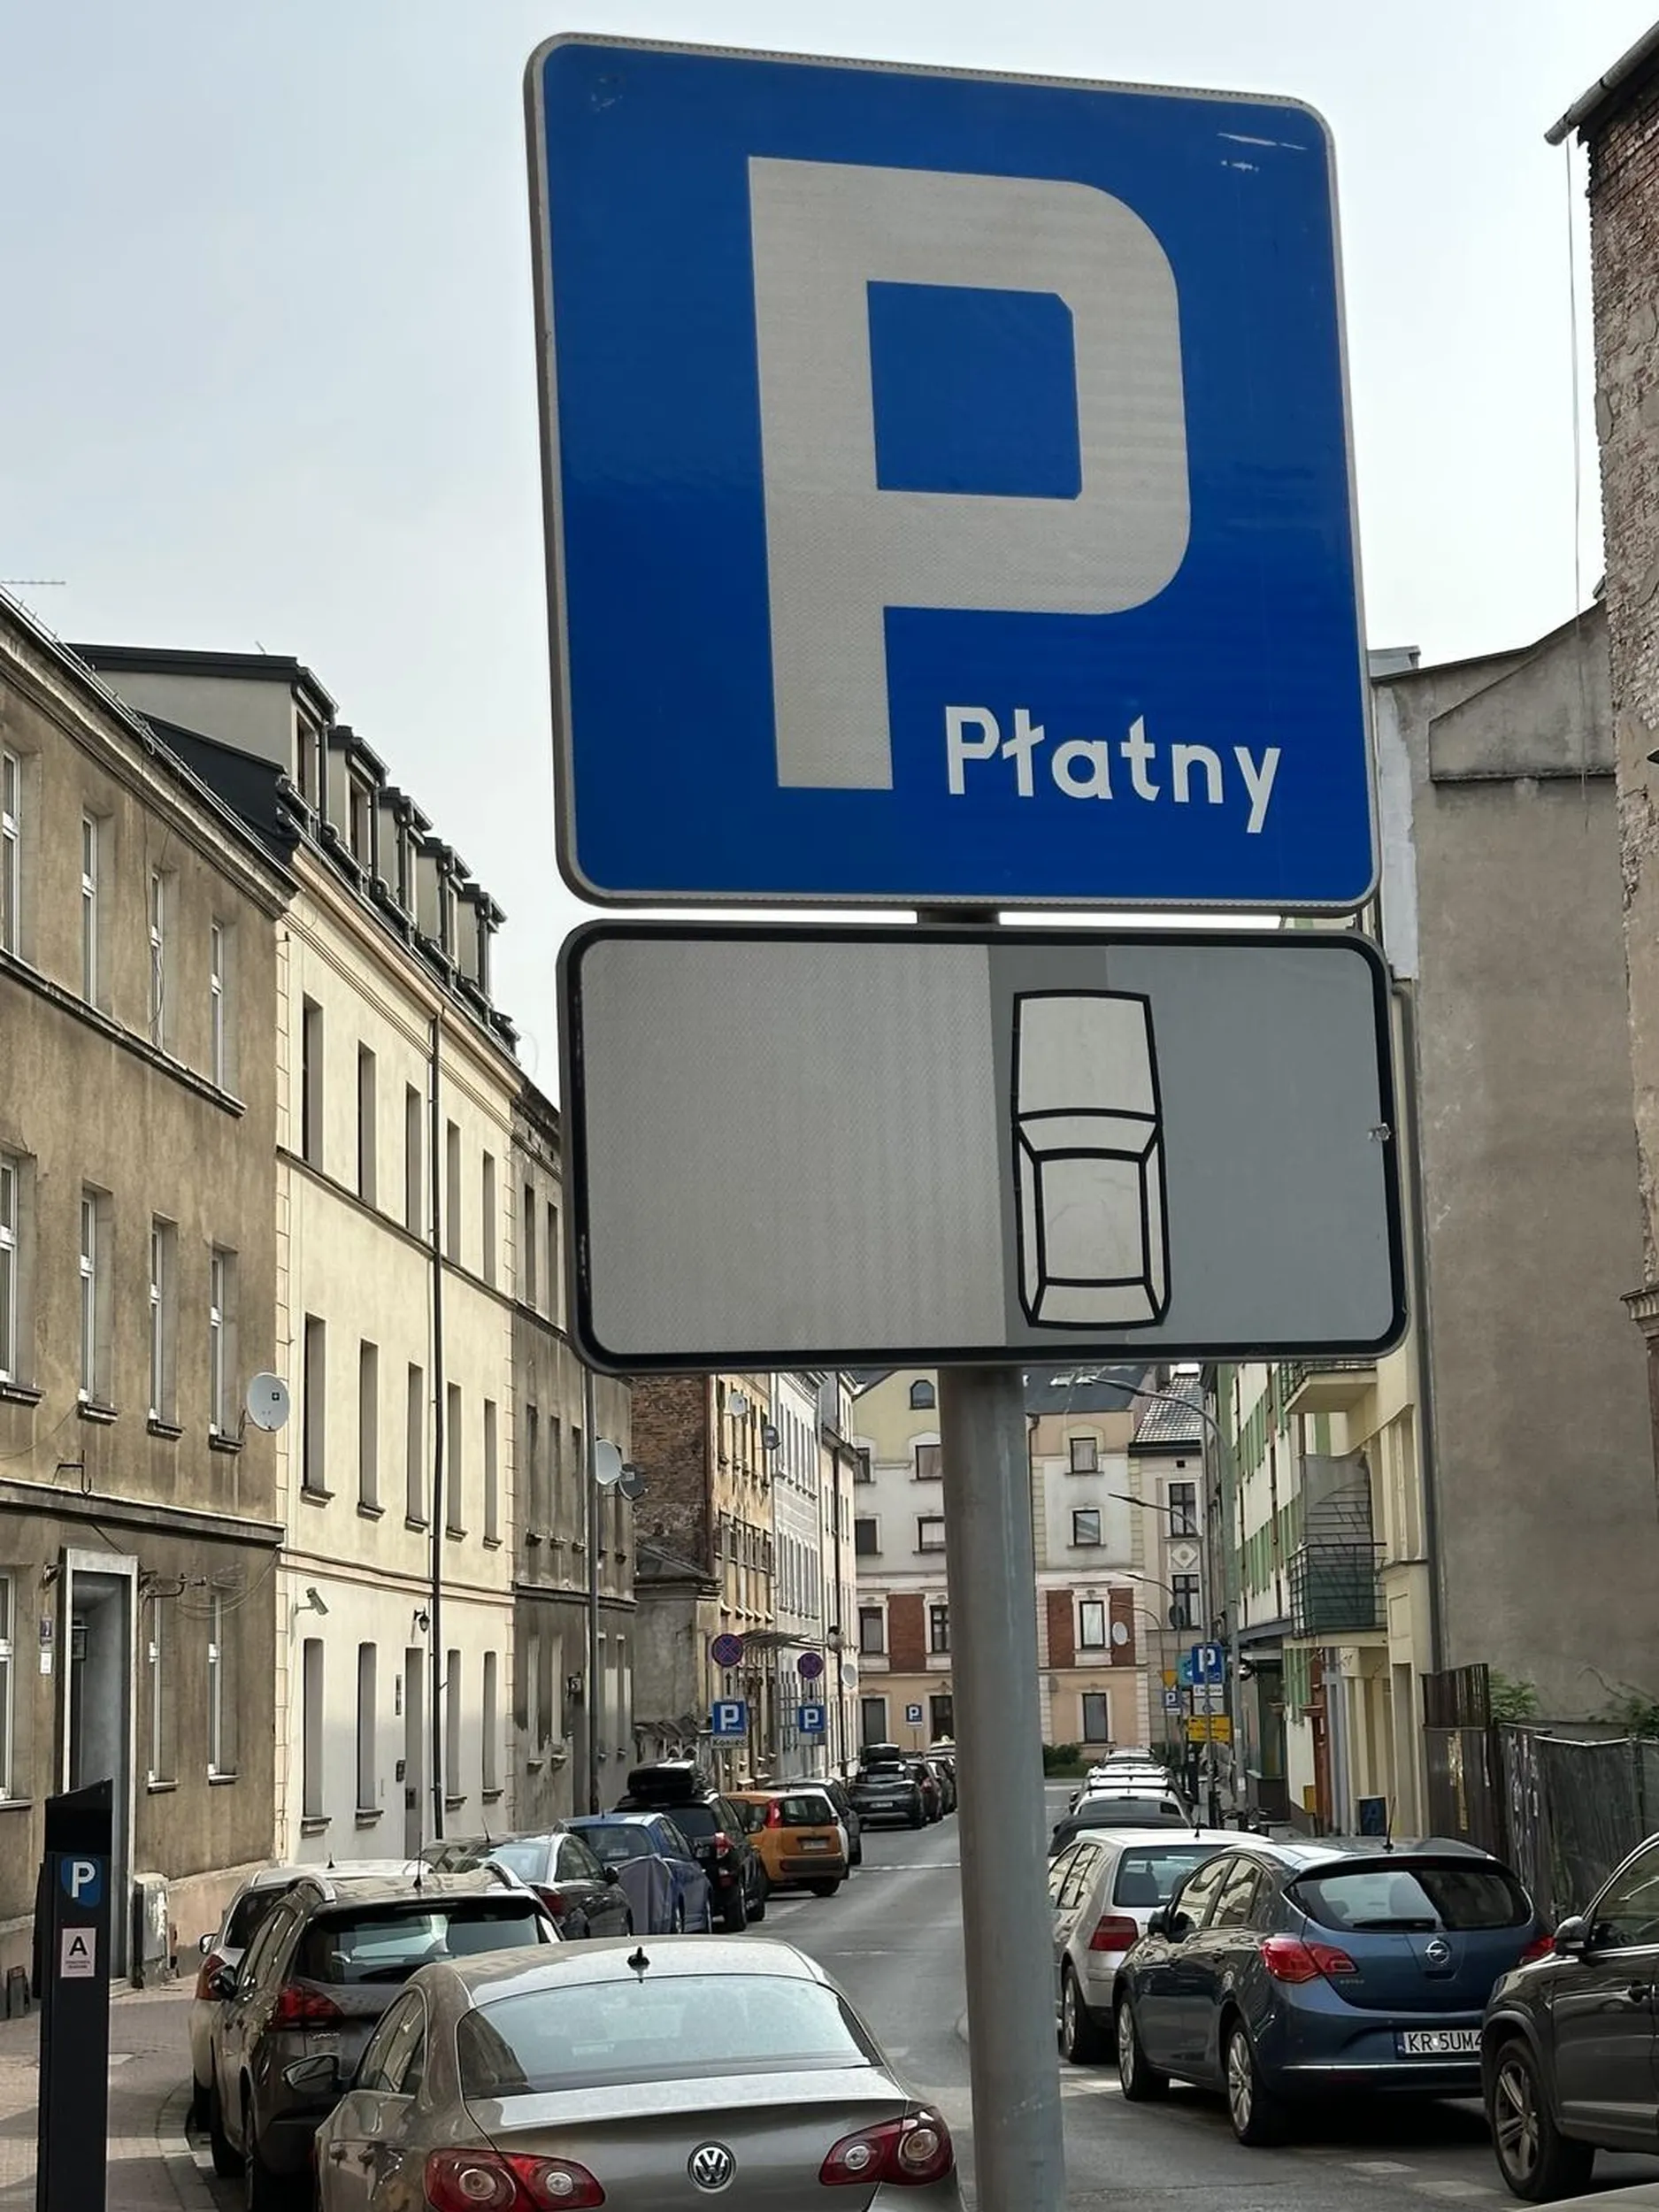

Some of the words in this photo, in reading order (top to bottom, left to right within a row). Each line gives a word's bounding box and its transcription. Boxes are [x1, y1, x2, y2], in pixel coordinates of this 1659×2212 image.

[748, 157, 1191, 790] P
[945, 705, 1281, 833] Płatny
[1197, 1647, 1217, 1672] P
[719, 1704, 740, 1732] P
[803, 1708, 819, 1730] P
[909, 1706, 919, 1720] P
[71, 1861, 96, 1899] P
[68, 1935, 88, 1956] A
[1408, 2033, 1433, 2052] KR
